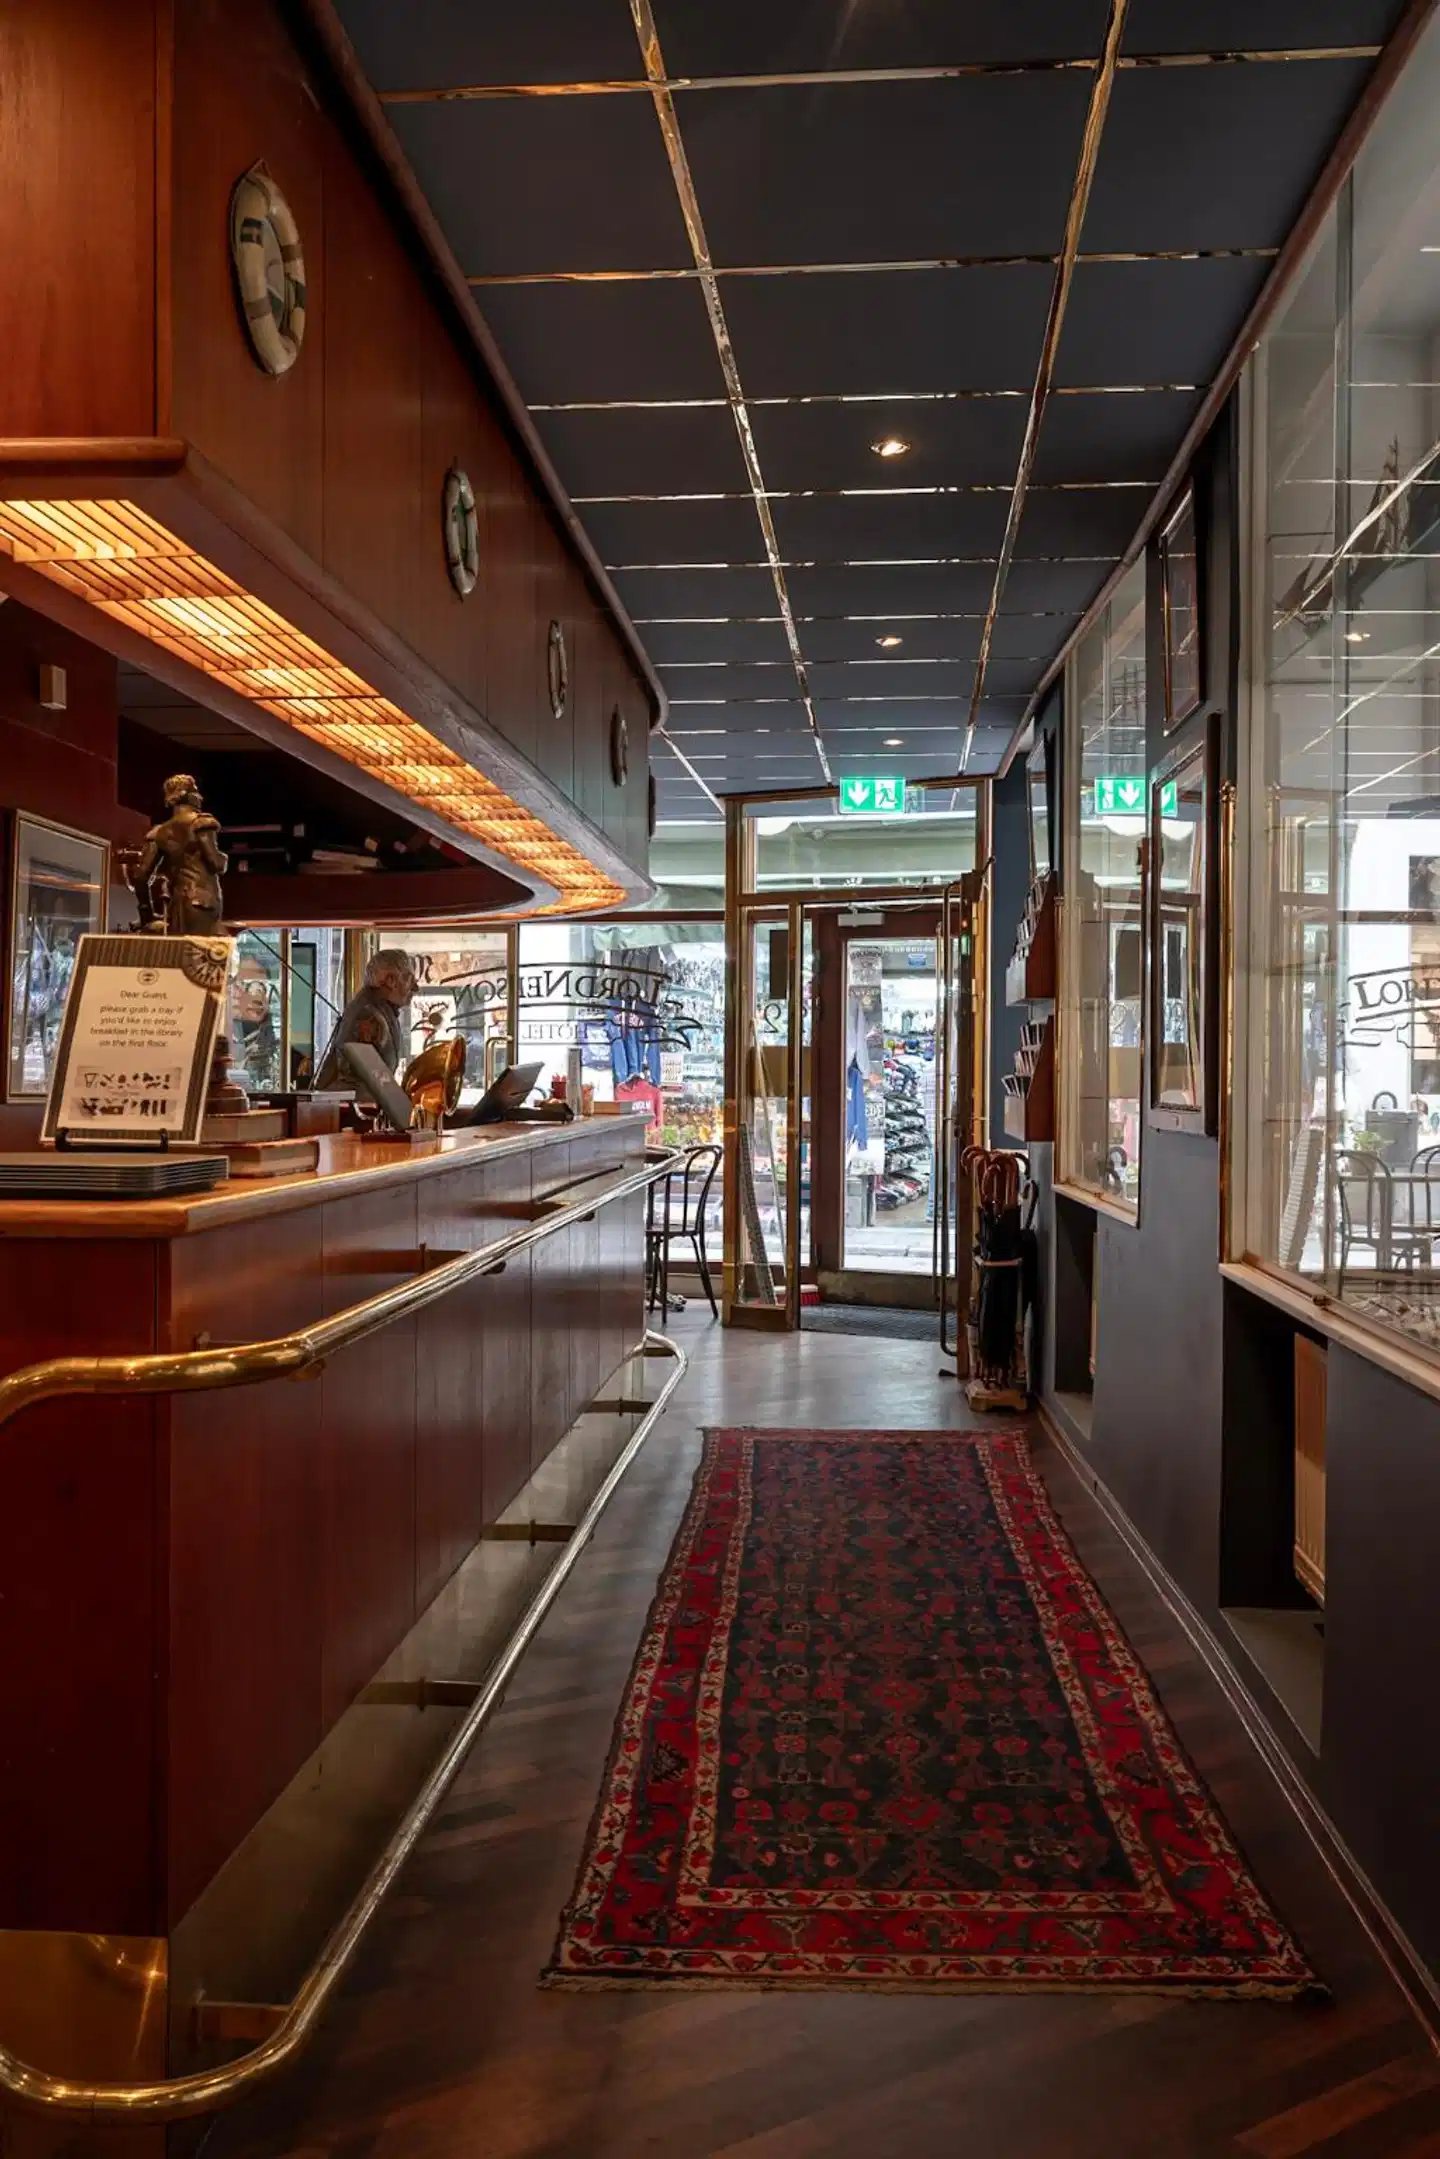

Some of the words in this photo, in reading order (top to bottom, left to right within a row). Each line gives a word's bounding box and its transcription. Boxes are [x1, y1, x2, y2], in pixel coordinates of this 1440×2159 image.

[120, 990, 139, 1000] Dear
[100, 1005, 127, 1014] please
[129, 1006, 150, 1015] grab
[158, 1006, 174, 1016] tray
[126, 1016, 141, 1024] like
[154, 1018, 178, 1027] enjoy
[89, 1026, 128, 1036] breakfast
[140, 1028, 153, 1036] the
[155, 1028, 183, 1038] library
[112, 1039, 126, 1047] the
[128, 1039, 145, 1048] first
